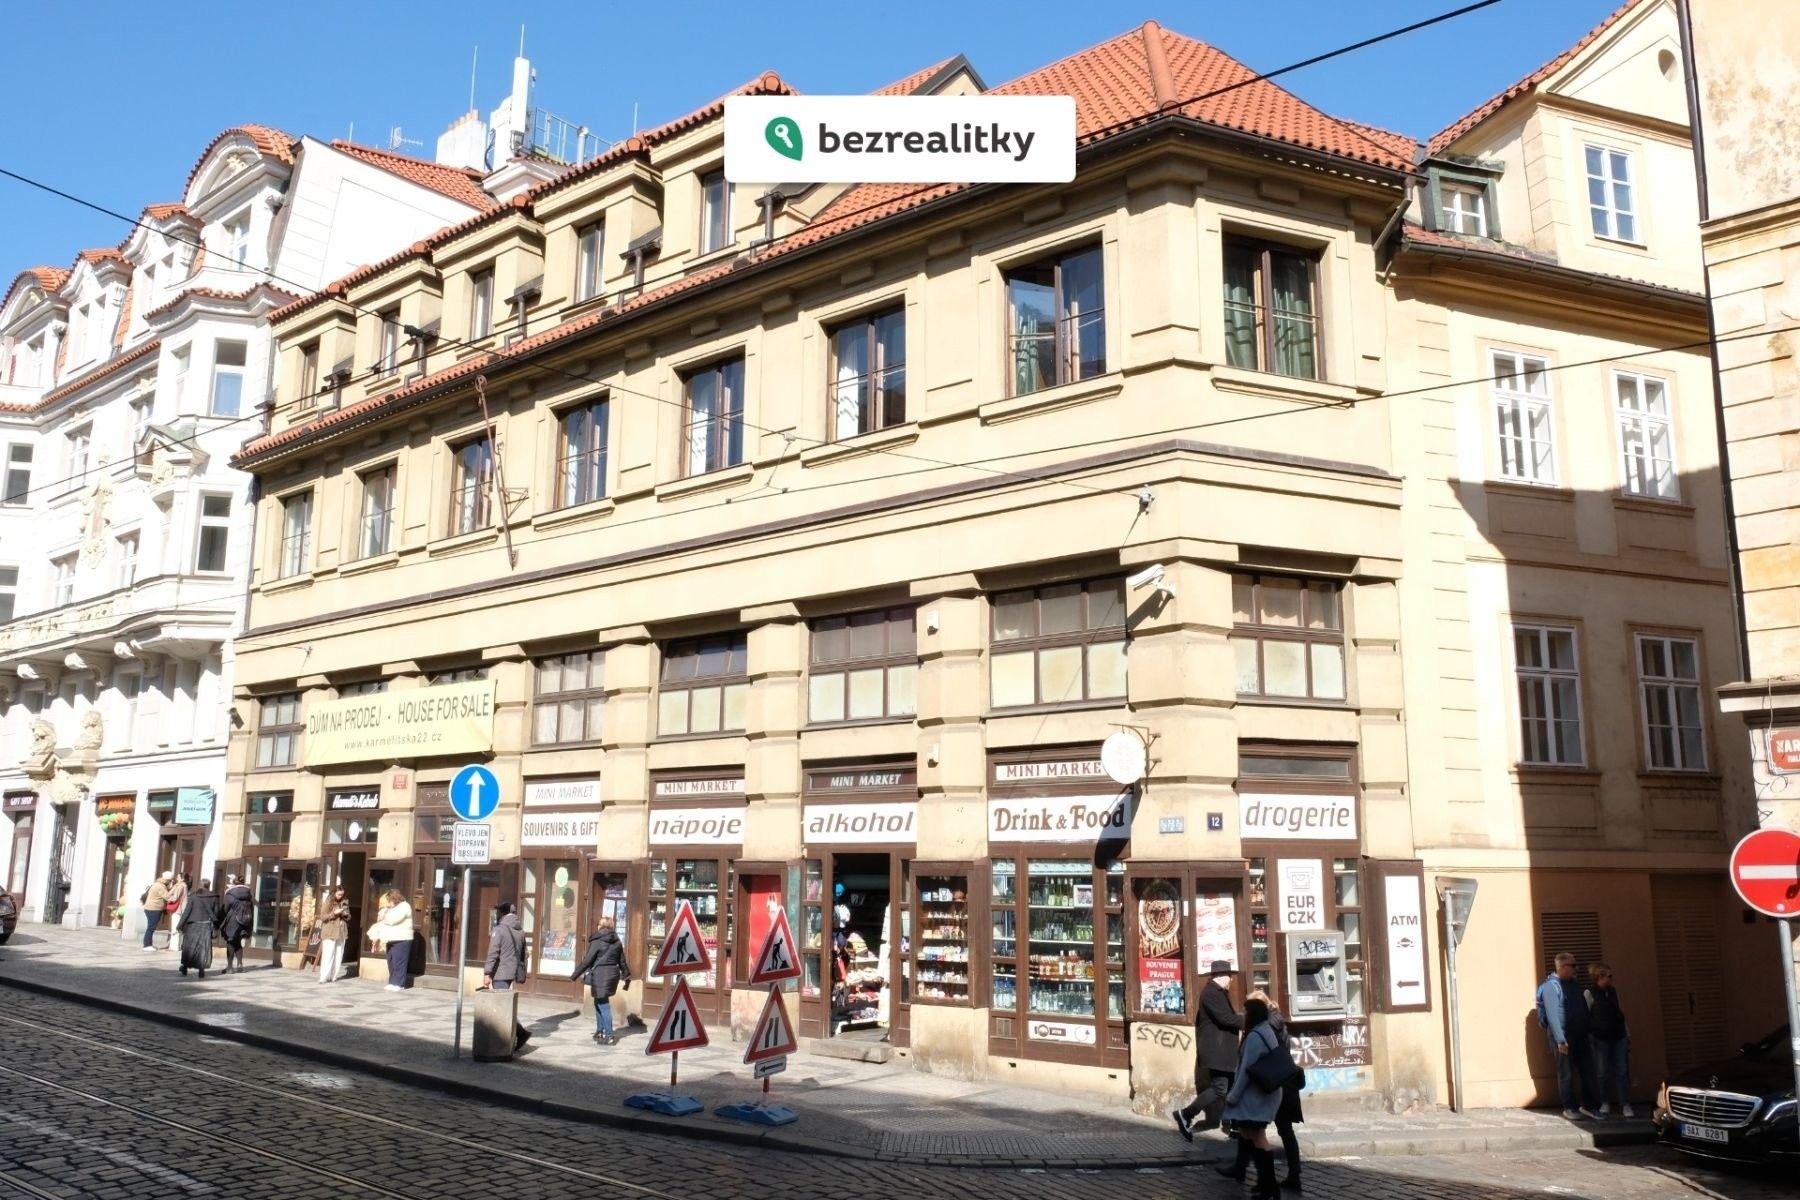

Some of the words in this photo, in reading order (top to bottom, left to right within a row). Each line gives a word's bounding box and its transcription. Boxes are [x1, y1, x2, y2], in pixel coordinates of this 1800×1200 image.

[344, 704, 382, 731] PRODEJ
[398, 699, 435, 724] HOUSE
[437, 696, 459, 720] FOR
[460, 693, 489, 718] SALE
[1006, 763, 1041, 778] MINI
[1046, 761, 1103, 776] MARKE
[663, 782, 688, 793] MINI
[691, 780, 737, 792] MARKET
[830, 775, 854, 788] MINI
[859, 773, 902, 786] MARKET
[535, 786, 555, 799] MINI
[557, 784, 594, 799] MARKET
[809, 811, 913, 833] alkohol
[994, 807, 1053, 832] Drink
[1055, 815, 1067, 830] &
[1069, 803, 1126, 830] Food
[1211, 816, 1221, 827] 12
[1245, 801, 1350, 832] drogerie
[524, 821, 569, 837] SOUVENIRS
[571, 821, 578, 836] &
[580, 821, 599, 836] GIFT
[653, 815, 742, 838] nápoje
[1287, 895, 1315, 908] EUR
[1287, 911, 1316, 924] CZK
[1391, 914, 1418, 926] ATM
